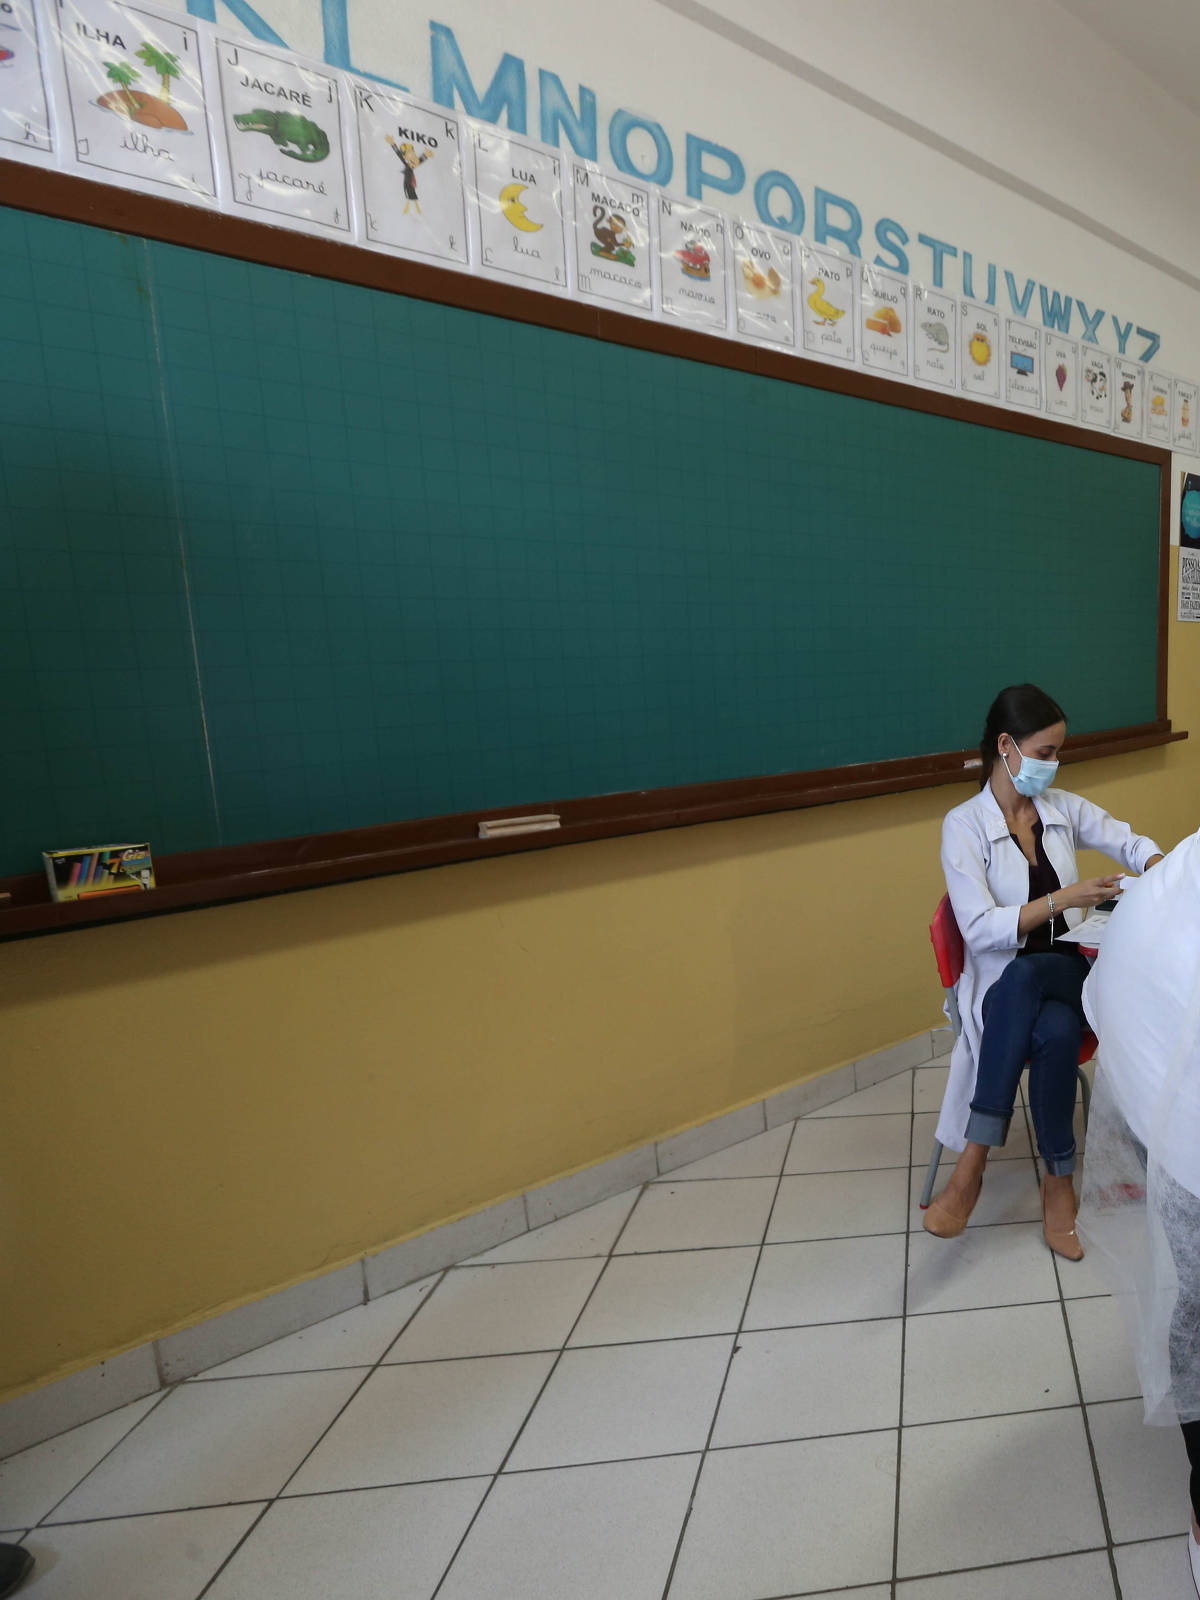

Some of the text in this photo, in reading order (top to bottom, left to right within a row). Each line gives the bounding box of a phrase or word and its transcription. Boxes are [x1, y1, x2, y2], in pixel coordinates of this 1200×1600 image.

[76, 22, 126, 50] ILHA
[228, 48, 239, 66] J
[240, 75, 313, 108] JACARÉ
[359, 91, 375, 112] K
[120, 131, 175, 162] ilha
[398, 126, 439, 149] KIKO
[478, 134, 489, 152] L
[257, 168, 328, 196] jacaré
[511, 168, 537, 185] LUA
[575, 168, 590, 188] M
[591, 192, 641, 217] MACACO
[662, 200, 673, 216] N
[680, 221, 712, 239] NAVIO
[512, 236, 542, 259] lua
[750, 247, 772, 261] OVO
[817, 267, 841, 281] PATO
[871, 288, 899, 304] QUEIJO
[926, 306, 946, 319] RATO
[975, 321, 989, 332] SOL
